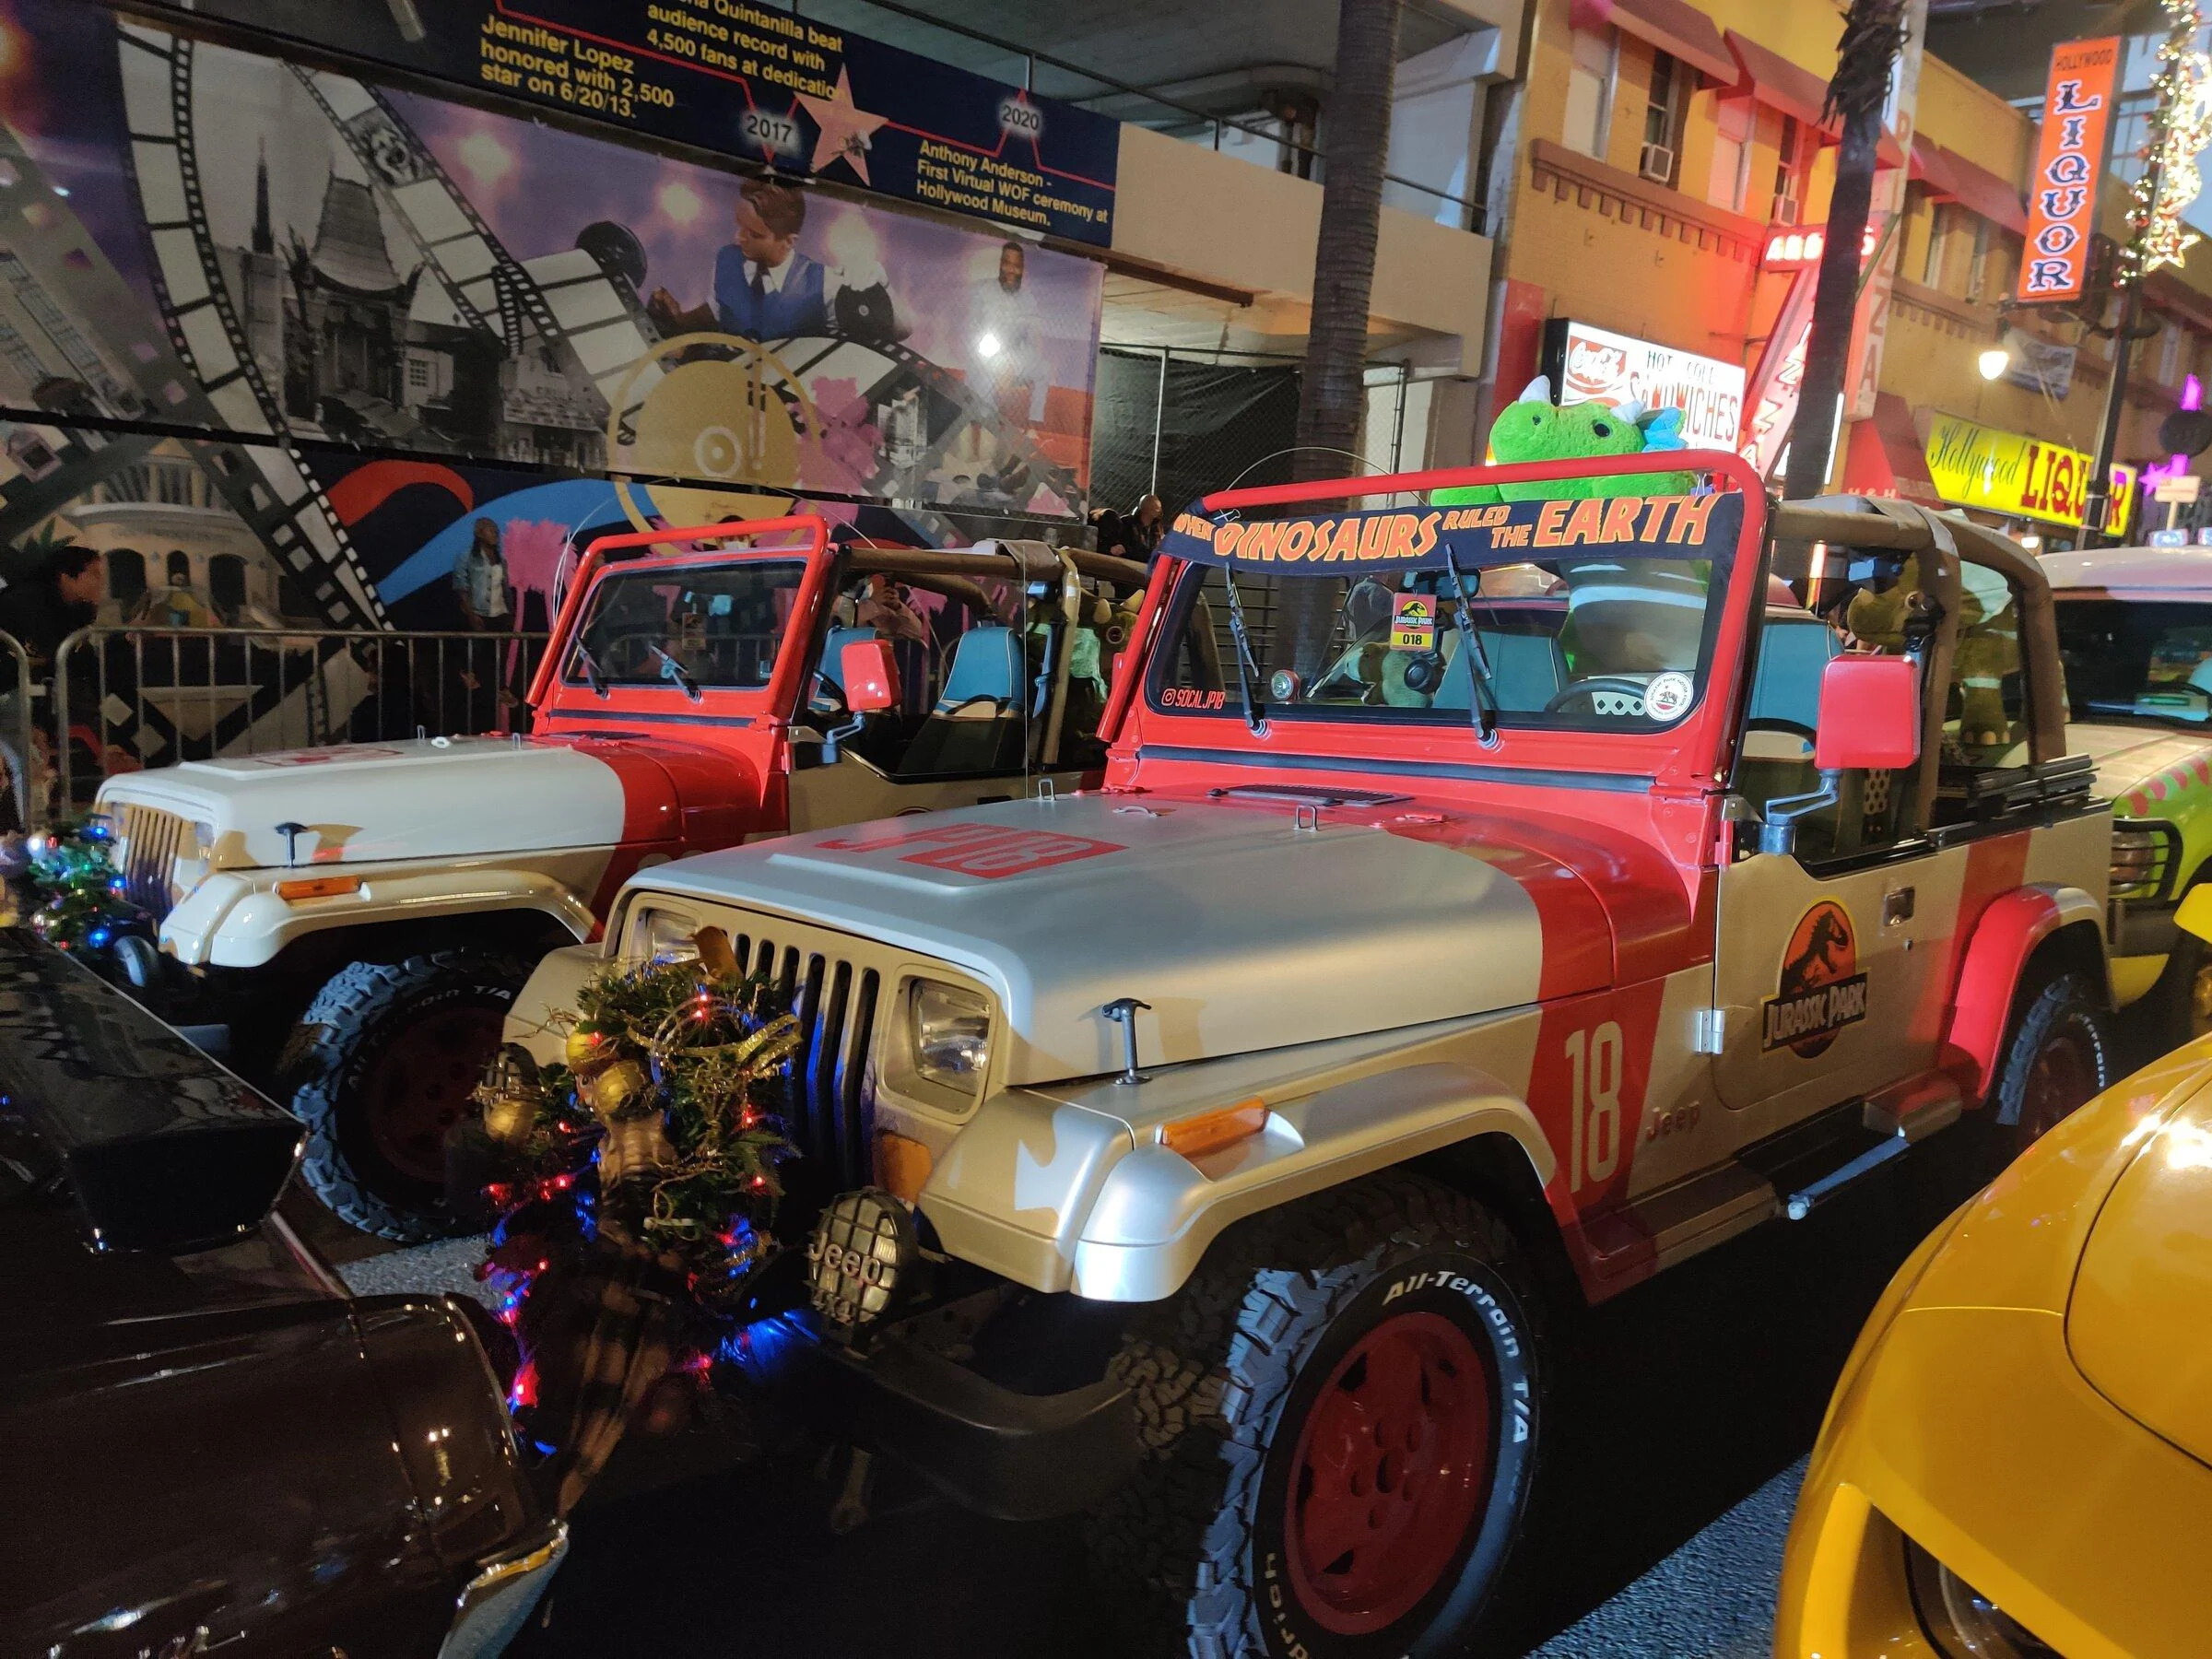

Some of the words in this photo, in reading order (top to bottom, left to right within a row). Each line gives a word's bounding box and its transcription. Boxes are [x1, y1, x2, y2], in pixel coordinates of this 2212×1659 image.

[481, 15, 570, 54] Jennifer
[574, 39, 634, 75] Lopez
[646, 29, 696, 56] 4,500
[700, 43, 737, 70] fans
[742, 60, 759, 76] at
[647, 4, 729, 42] audience
[734, 29, 788, 61] record
[793, 50, 826, 71] with
[714, 0, 804, 41] Quintanilla
[808, 26, 843, 53] beat
[480, 37, 570, 79] honored
[575, 67, 616, 92] with
[621, 78, 675, 109] 2,500
[2055, 49, 2113, 71] HOLLYWOOD
[481, 63, 523, 88] star
[527, 76, 554, 96] on
[559, 82, 637, 119] 6/20/13.
[1003, 105, 1040, 131] 2020
[747, 115, 793, 143] 2017
[917, 159, 948, 181] First
[953, 168, 994, 194] Virtual
[998, 181, 1031, 202] WOF
[1033, 193, 1095, 223] ceremony
[1096, 209, 1109, 224] at
[920, 140, 978, 171] Anthony
[981, 158, 1043, 187] Anderson
[2026, 79, 2101, 292] LIQUOR
[916, 180, 989, 210] Hollywood
[992, 198, 1052, 226] Museum.
[2020, 444, 2128, 530] LIQUR
[1173, 512, 1217, 542] WHEN
[1214, 511, 1441, 561] DINOSAURS
[1441, 505, 1512, 530] RULED
[1490, 524, 1533, 548] THE
[1533, 494, 1727, 547] EARTH
[1403, 633, 1422, 645] 018
[1828, 982, 1866, 1029] PARK
[1567, 1020, 1623, 1193] 18
[1645, 1101, 1701, 1142] Jeep
[809, 1232, 882, 1289] Jeep
[1382, 1271, 1520, 1359] All-Terrain
